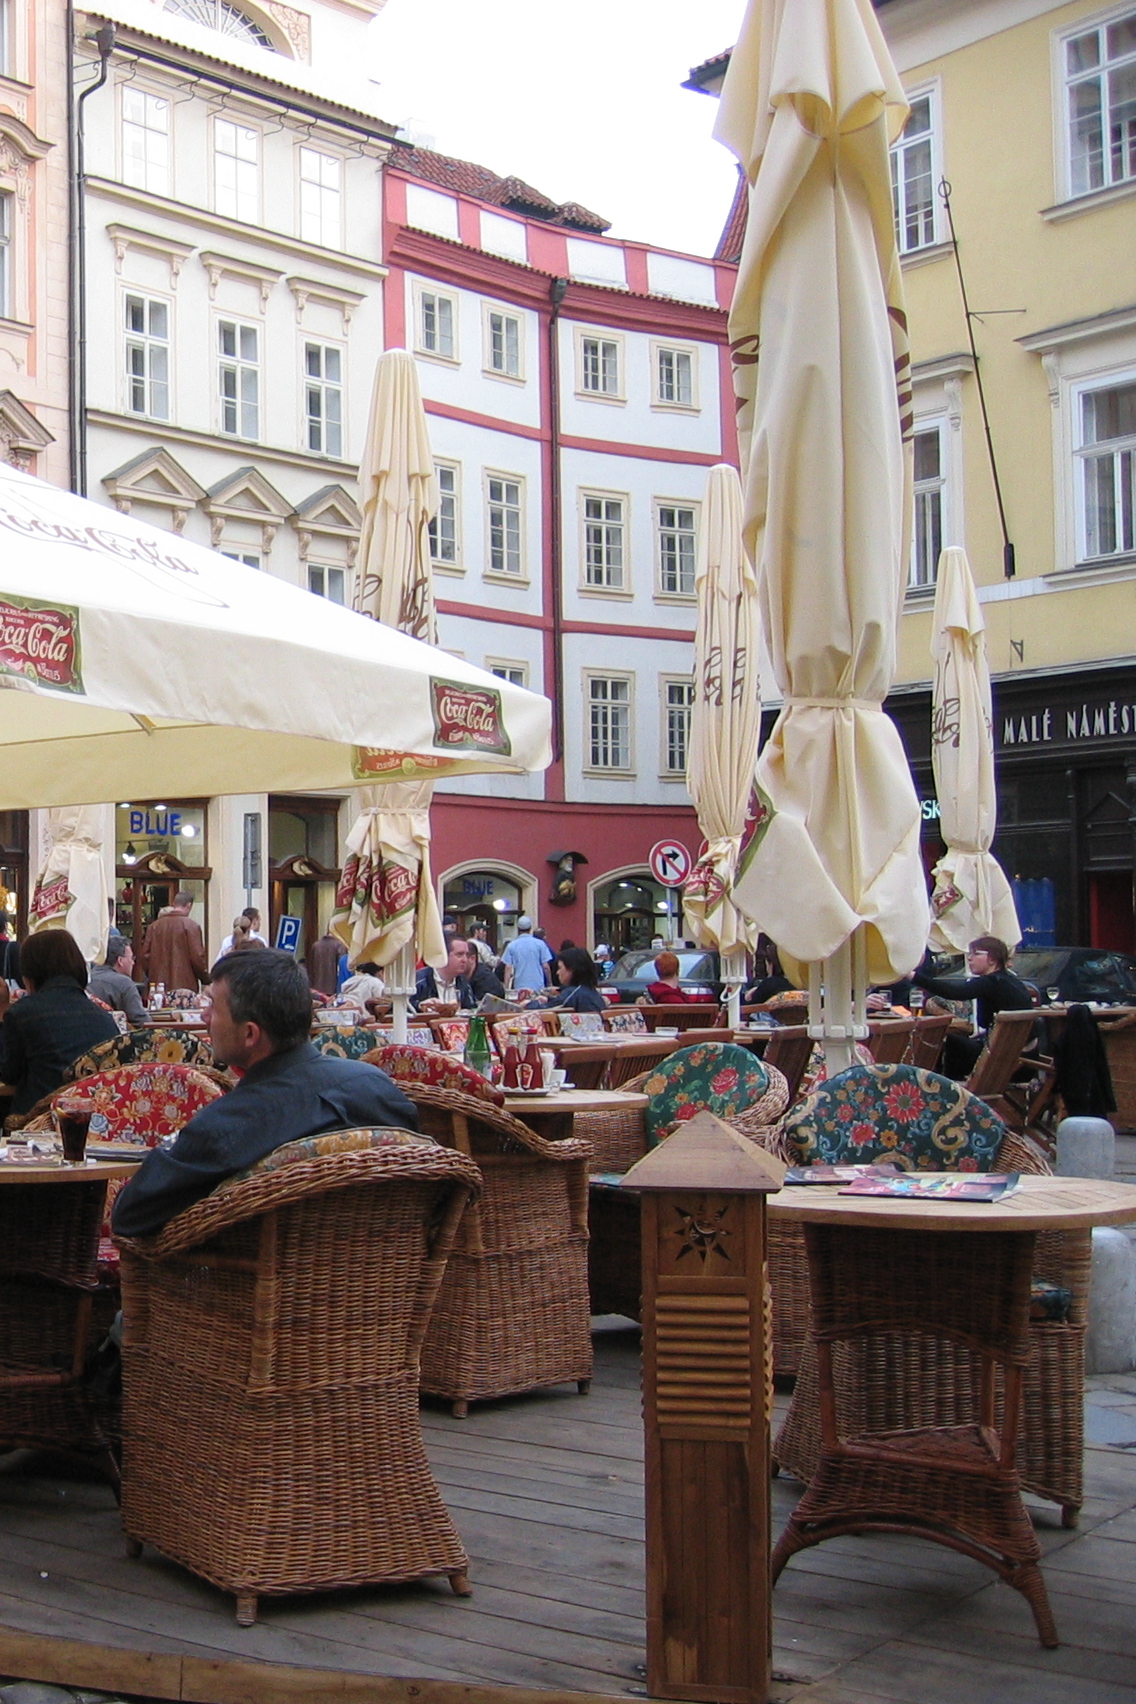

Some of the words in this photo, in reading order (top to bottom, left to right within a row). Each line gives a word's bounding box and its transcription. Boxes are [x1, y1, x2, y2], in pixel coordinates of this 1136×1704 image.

[440, 696, 495, 732] Coca-Cola
[1003, 708, 1052, 744] MALÉ
[130, 811, 181, 836] BLUE
[463, 880, 494, 895] BLUE
[281, 921, 296, 944] P
